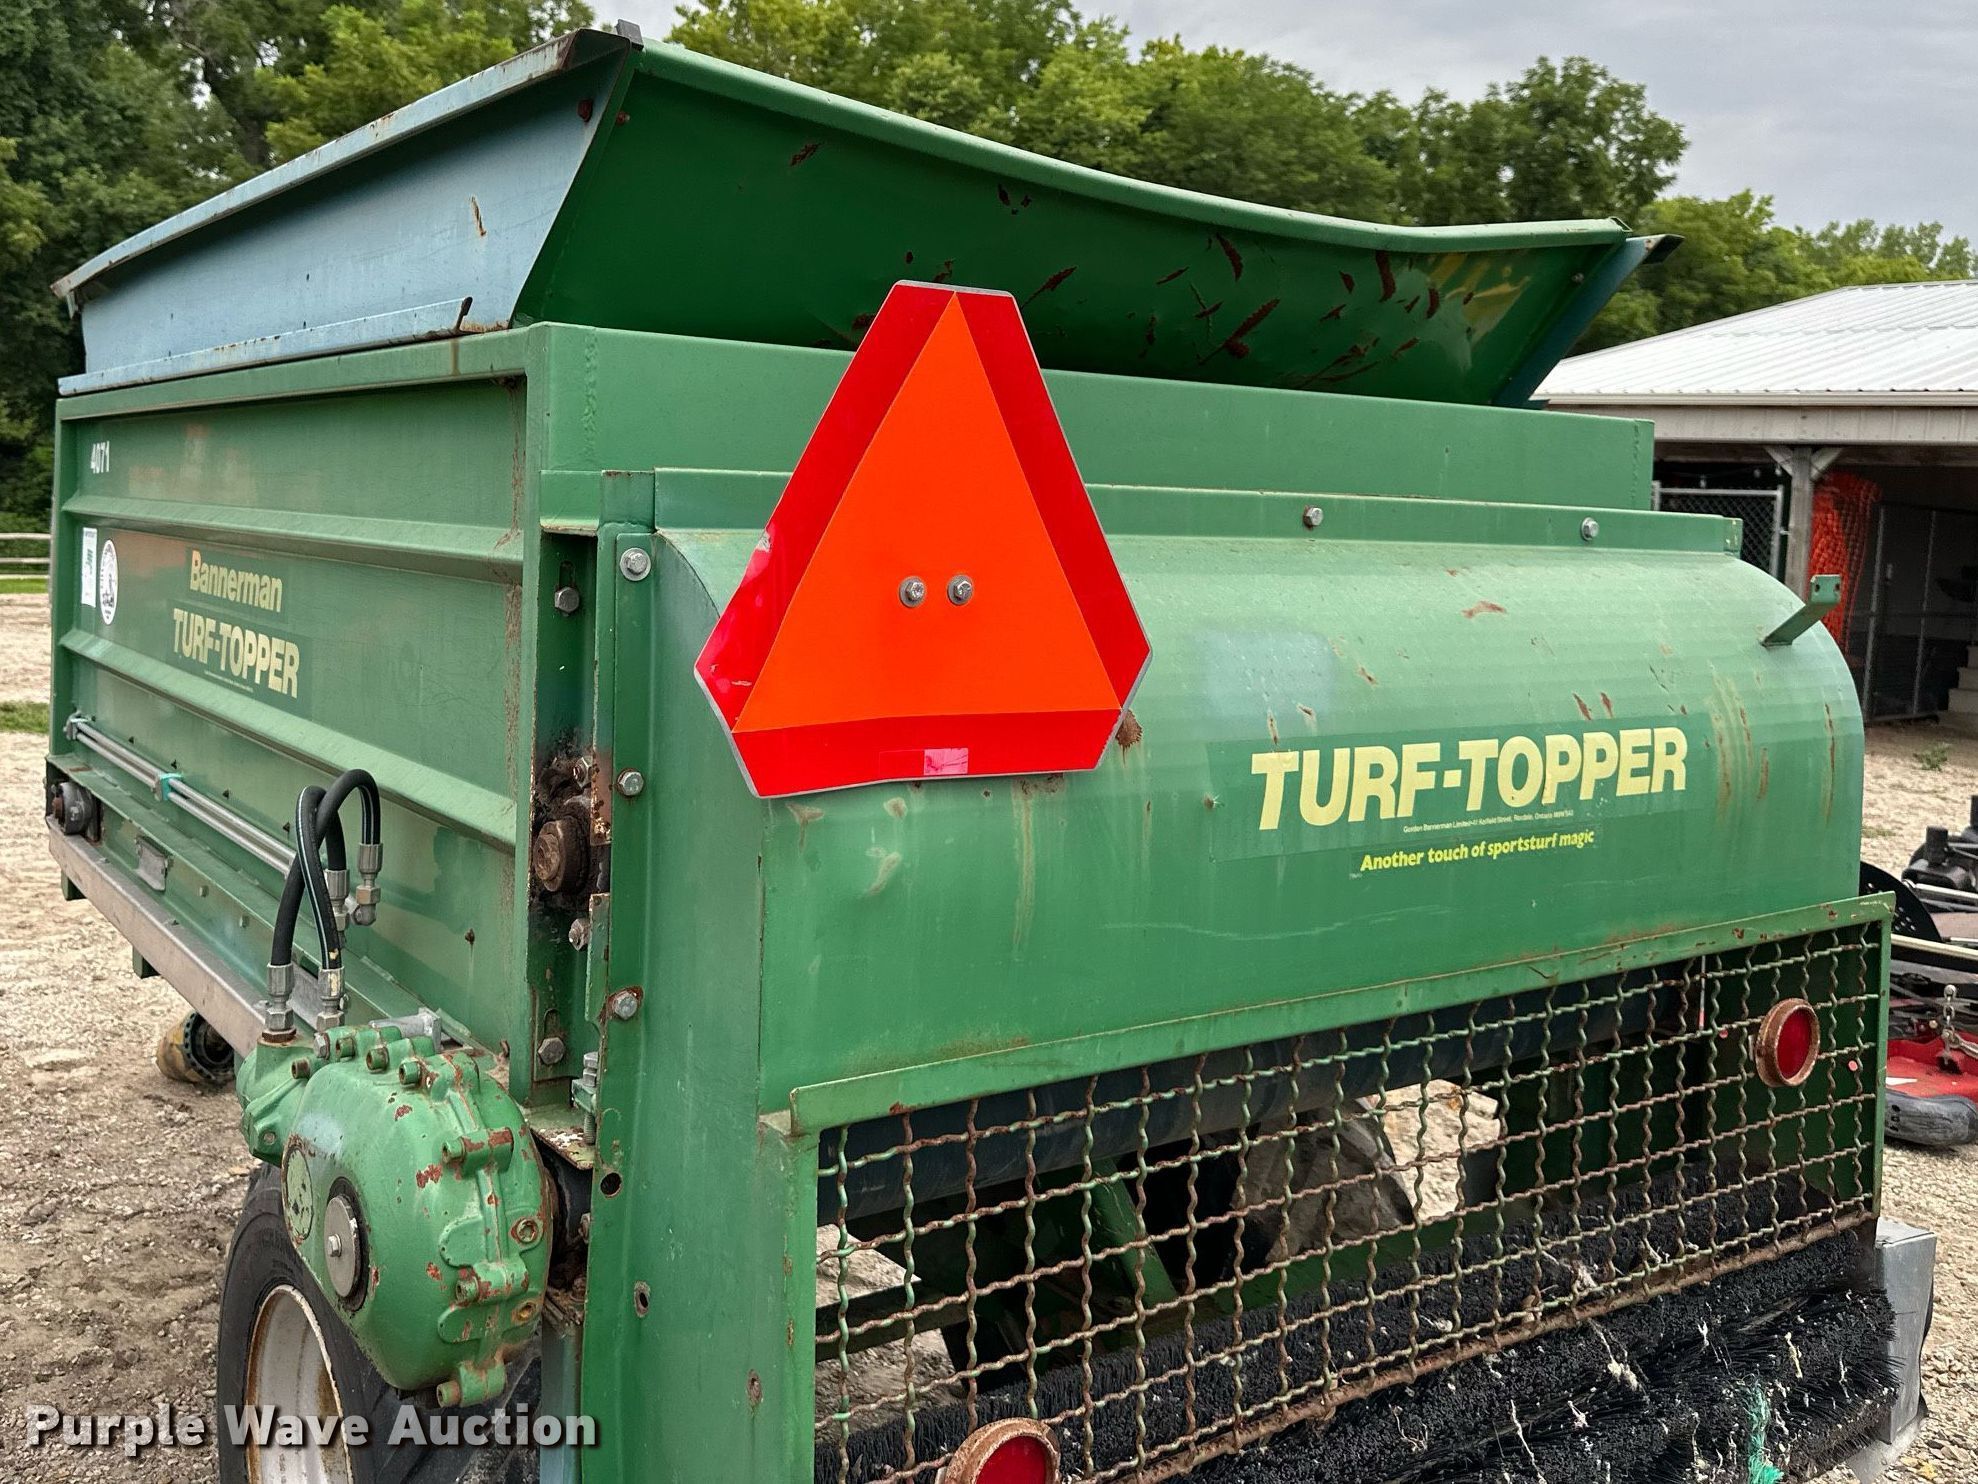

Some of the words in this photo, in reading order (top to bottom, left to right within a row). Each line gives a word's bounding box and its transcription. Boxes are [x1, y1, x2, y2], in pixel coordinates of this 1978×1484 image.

[91, 440, 110, 474] 4071
[190, 550, 282, 612] Bannerman
[173, 607, 300, 699] TURF-TOPPER
[1251, 727, 1688, 831] TURF-TOPPER
[1360, 850, 1424, 871] Another
[1427, 843, 1468, 863] touch
[1471, 841, 1486, 858] of
[1487, 832, 1559, 859] sportsturf
[1559, 829, 1595, 849] magic
[1403, 825, 1422, 833] Gordon
[1423, 822, 1452, 831] Bannerman
